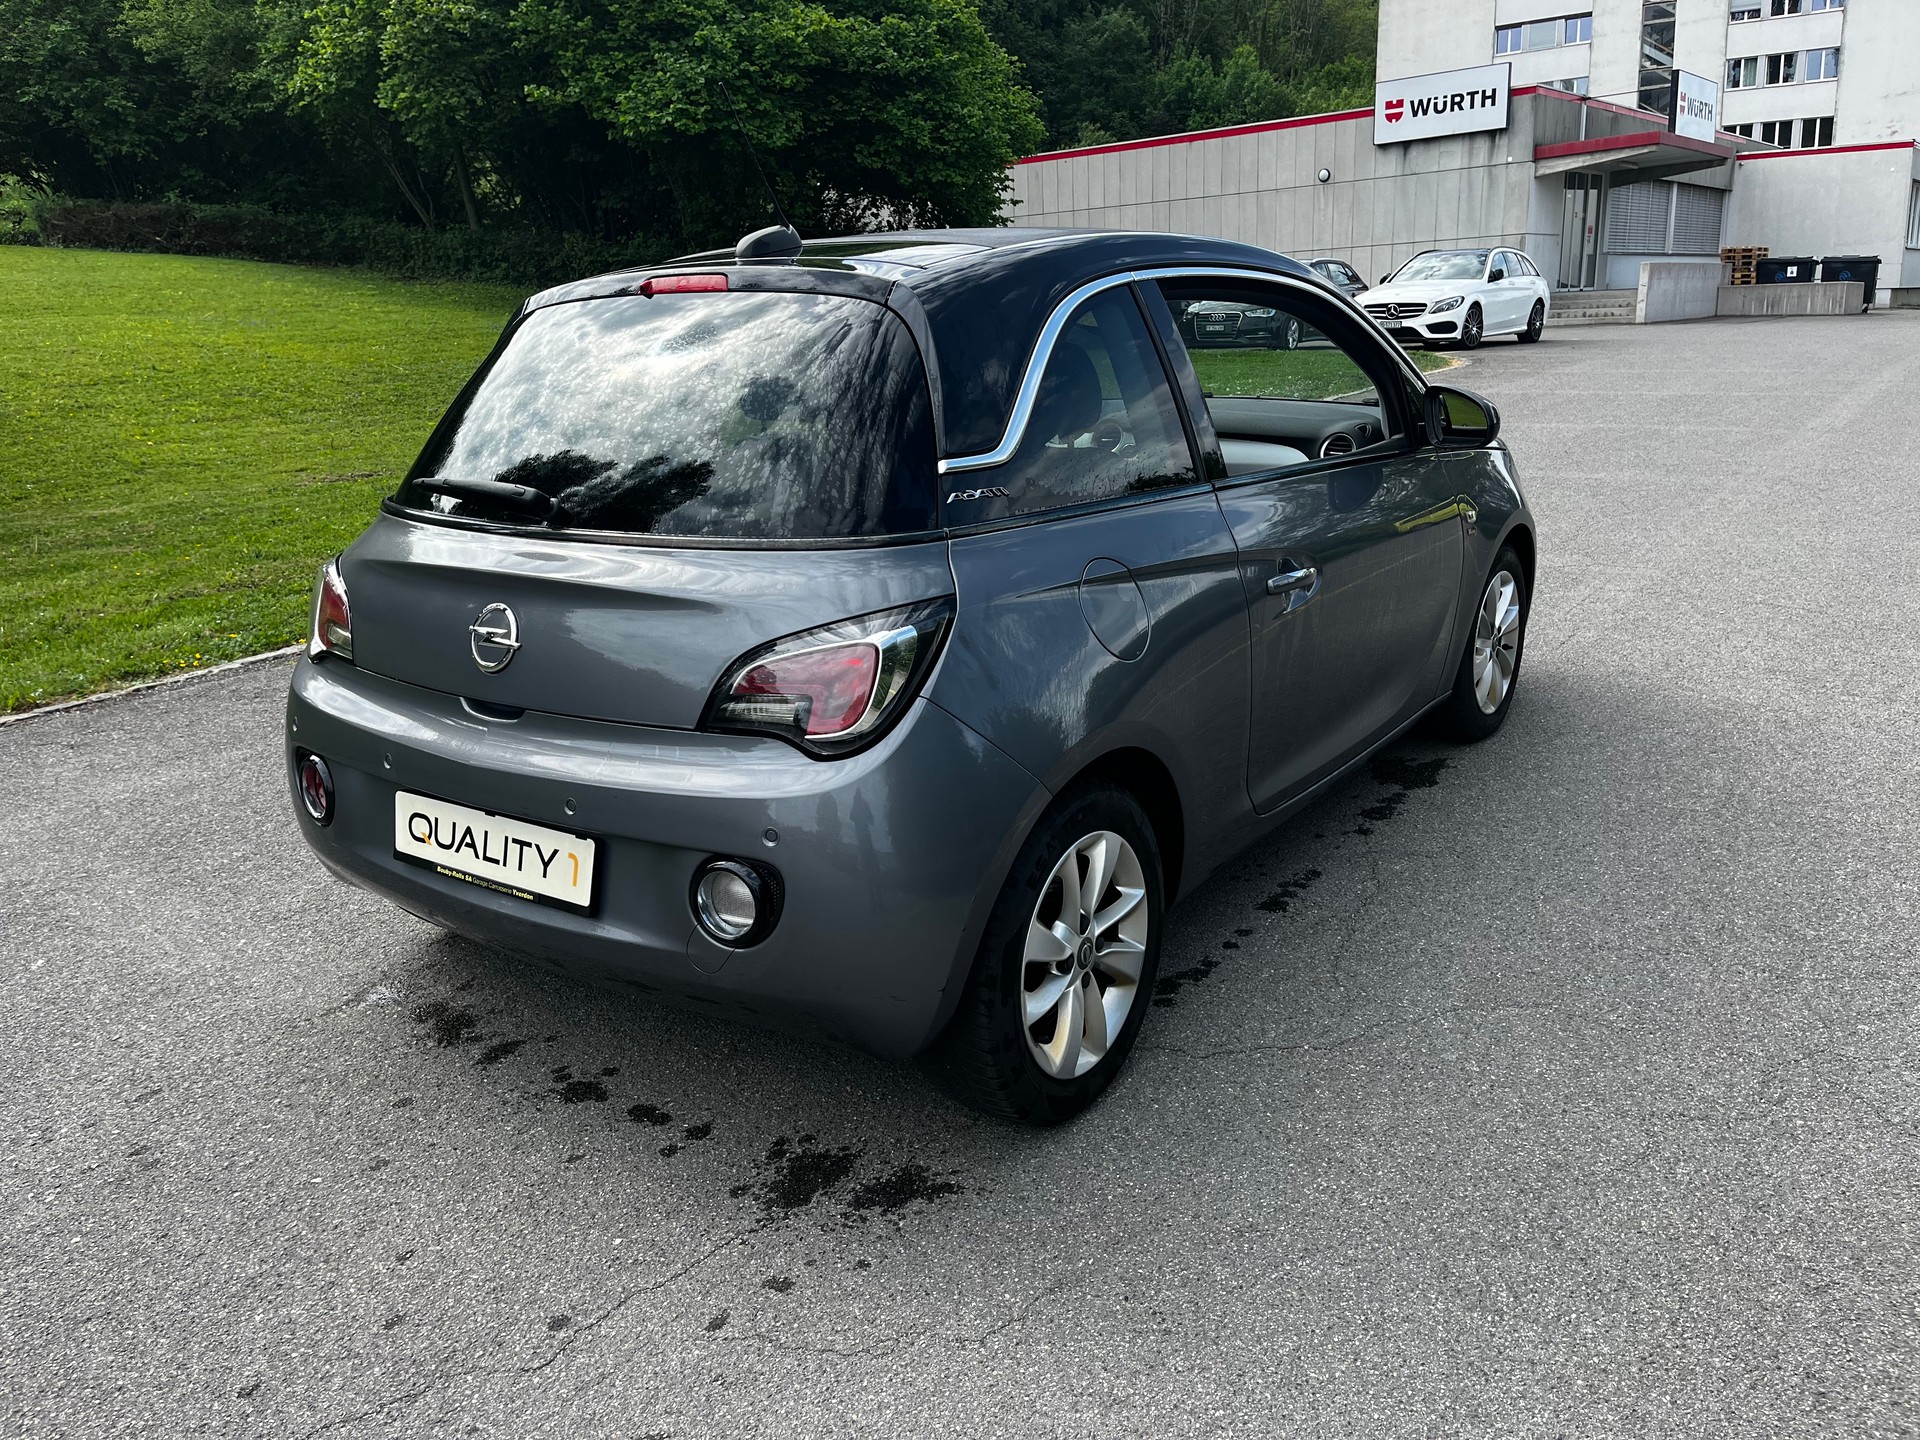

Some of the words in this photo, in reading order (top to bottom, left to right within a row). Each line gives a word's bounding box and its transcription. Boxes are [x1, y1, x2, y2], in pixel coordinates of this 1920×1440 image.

[1409, 88, 1497, 118] WÜRTH
[1687, 97, 1713, 122] WÜRTH
[408, 812, 560, 879] QUALITY
[567, 852, 580, 887] 1
[465, 874, 473, 882] SA
[473, 877, 488, 888] Garage
[512, 888, 534, 901] Yverdon
